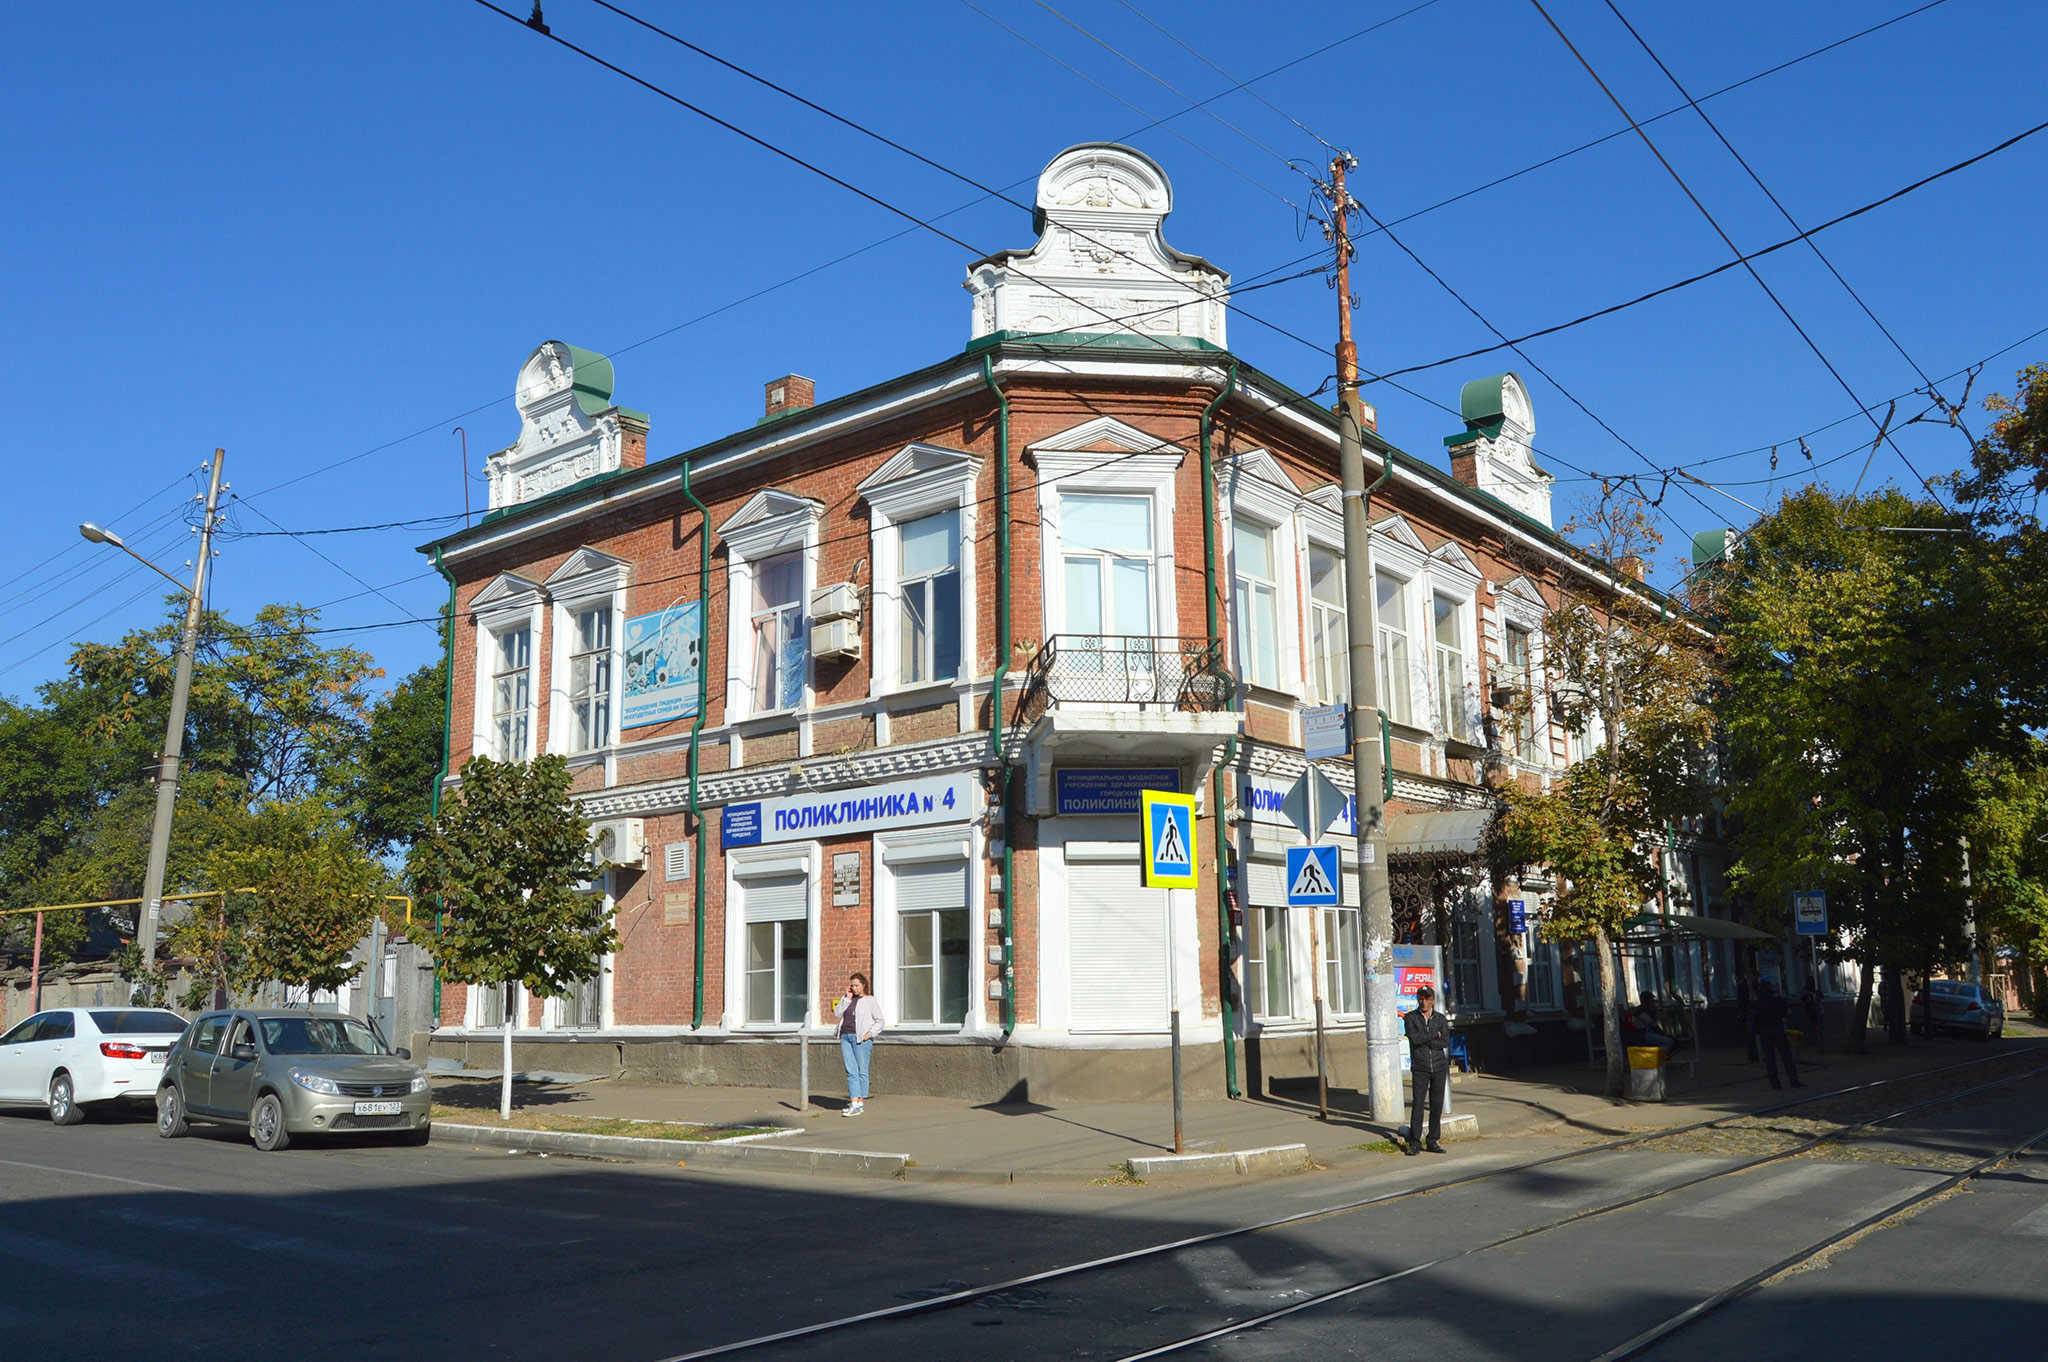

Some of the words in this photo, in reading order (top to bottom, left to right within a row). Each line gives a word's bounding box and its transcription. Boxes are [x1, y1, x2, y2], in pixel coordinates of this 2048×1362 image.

[775, 792, 919, 831] ПОЛИКЛИНИКА
[942, 787, 956, 810] 4
[1064, 799, 1139, 810] ПОЛИКЛИНИ
[154, 1052, 167, 1060] К68
